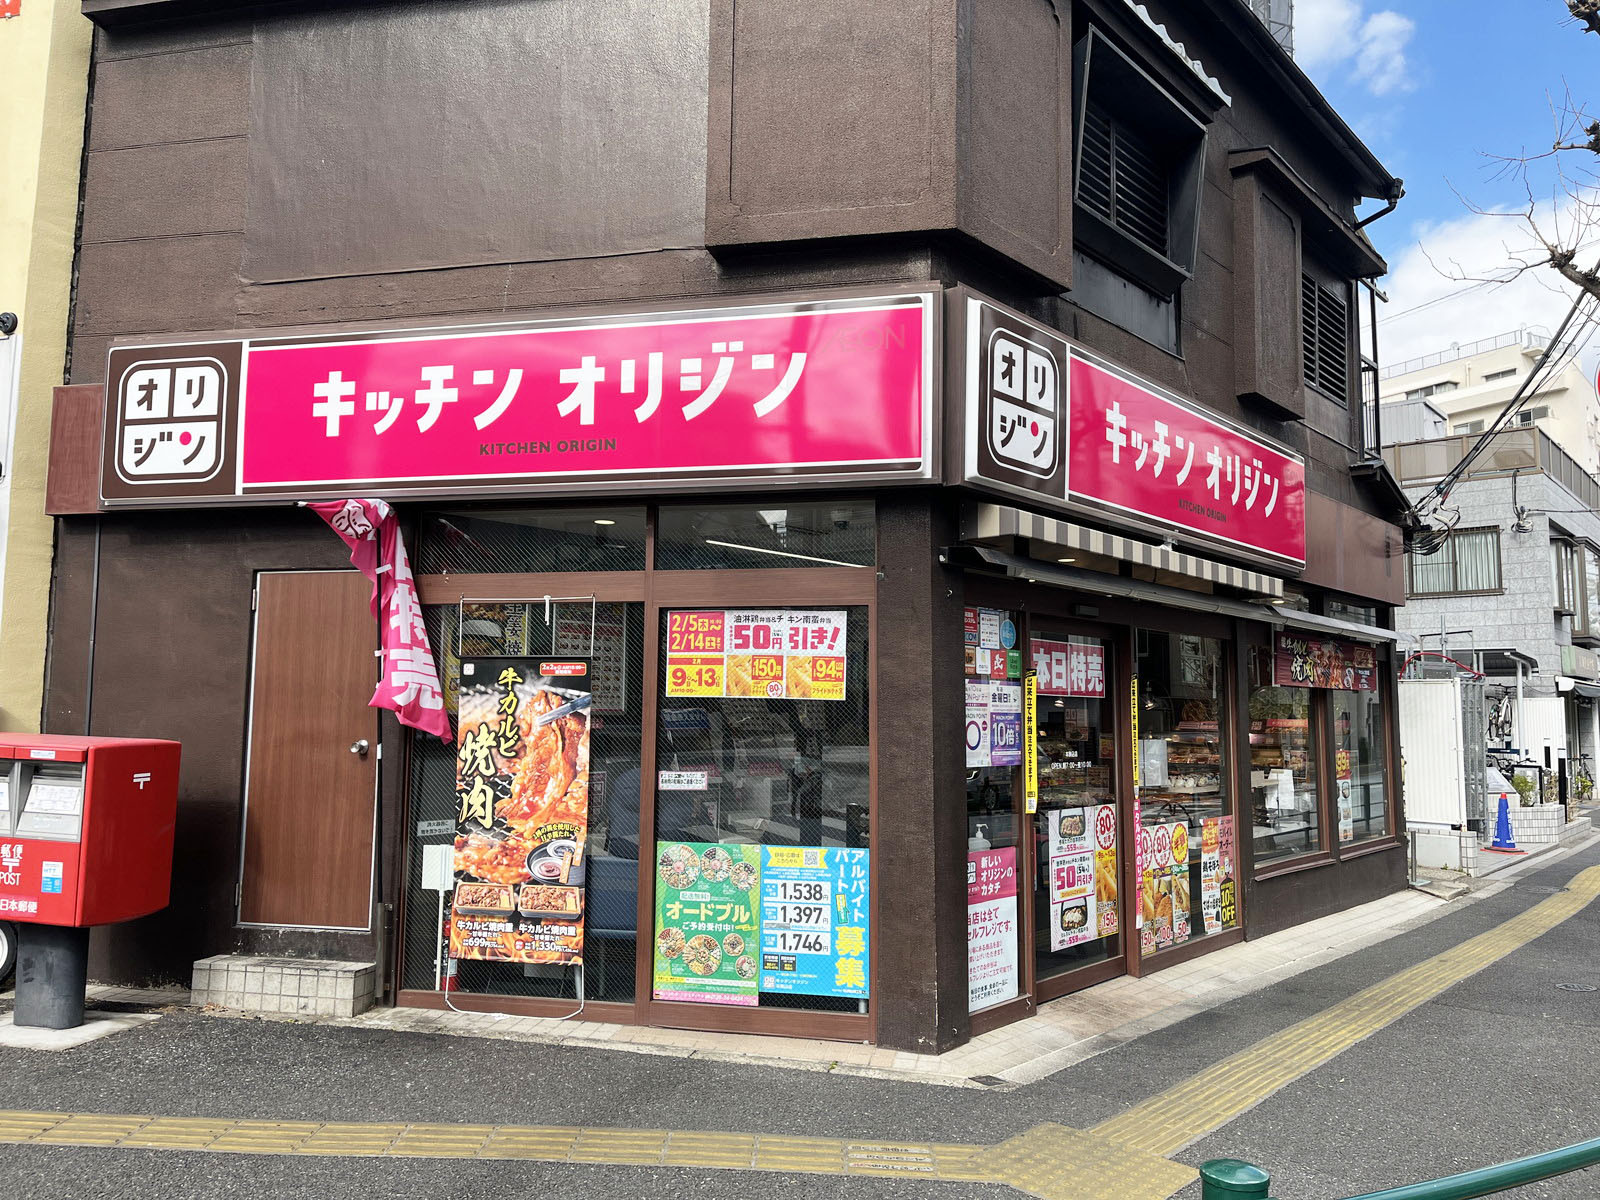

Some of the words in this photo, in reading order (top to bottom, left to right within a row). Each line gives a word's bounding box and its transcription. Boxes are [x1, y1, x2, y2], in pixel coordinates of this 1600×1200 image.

[312, 364, 523, 437] キッチン
[556, 341, 807, 425] オリジン
[479, 441, 551, 456] KITCHEN
[557, 438, 617, 453] ORIGIN
[1105, 401, 1195, 487] キッチン
[1206, 445, 1279, 518] オリジン
[1178, 499, 1204, 515] KITCHEN
[1206, 507, 1227, 523] ORIGIN
[1033, 648, 1104, 692] 本日特売
[498, 666, 523, 757] 牛カルビ
[459, 723, 497, 829] 焼肉
[0, 844, 23, 859] 郵便
[981, 855, 1002, 869] 新しい
[0, 871, 21, 886] POST
[835, 849, 849, 893] パート
[981, 866, 1013, 882] オリジンの
[851, 850, 866, 922] アルバイト
[981, 882, 1001, 897] カタチ
[0, 898, 38, 914] 日本郵便
[665, 901, 750, 923] オードブル
[1221, 905, 1235, 922] OFF
[835, 926, 866, 988] 募集
